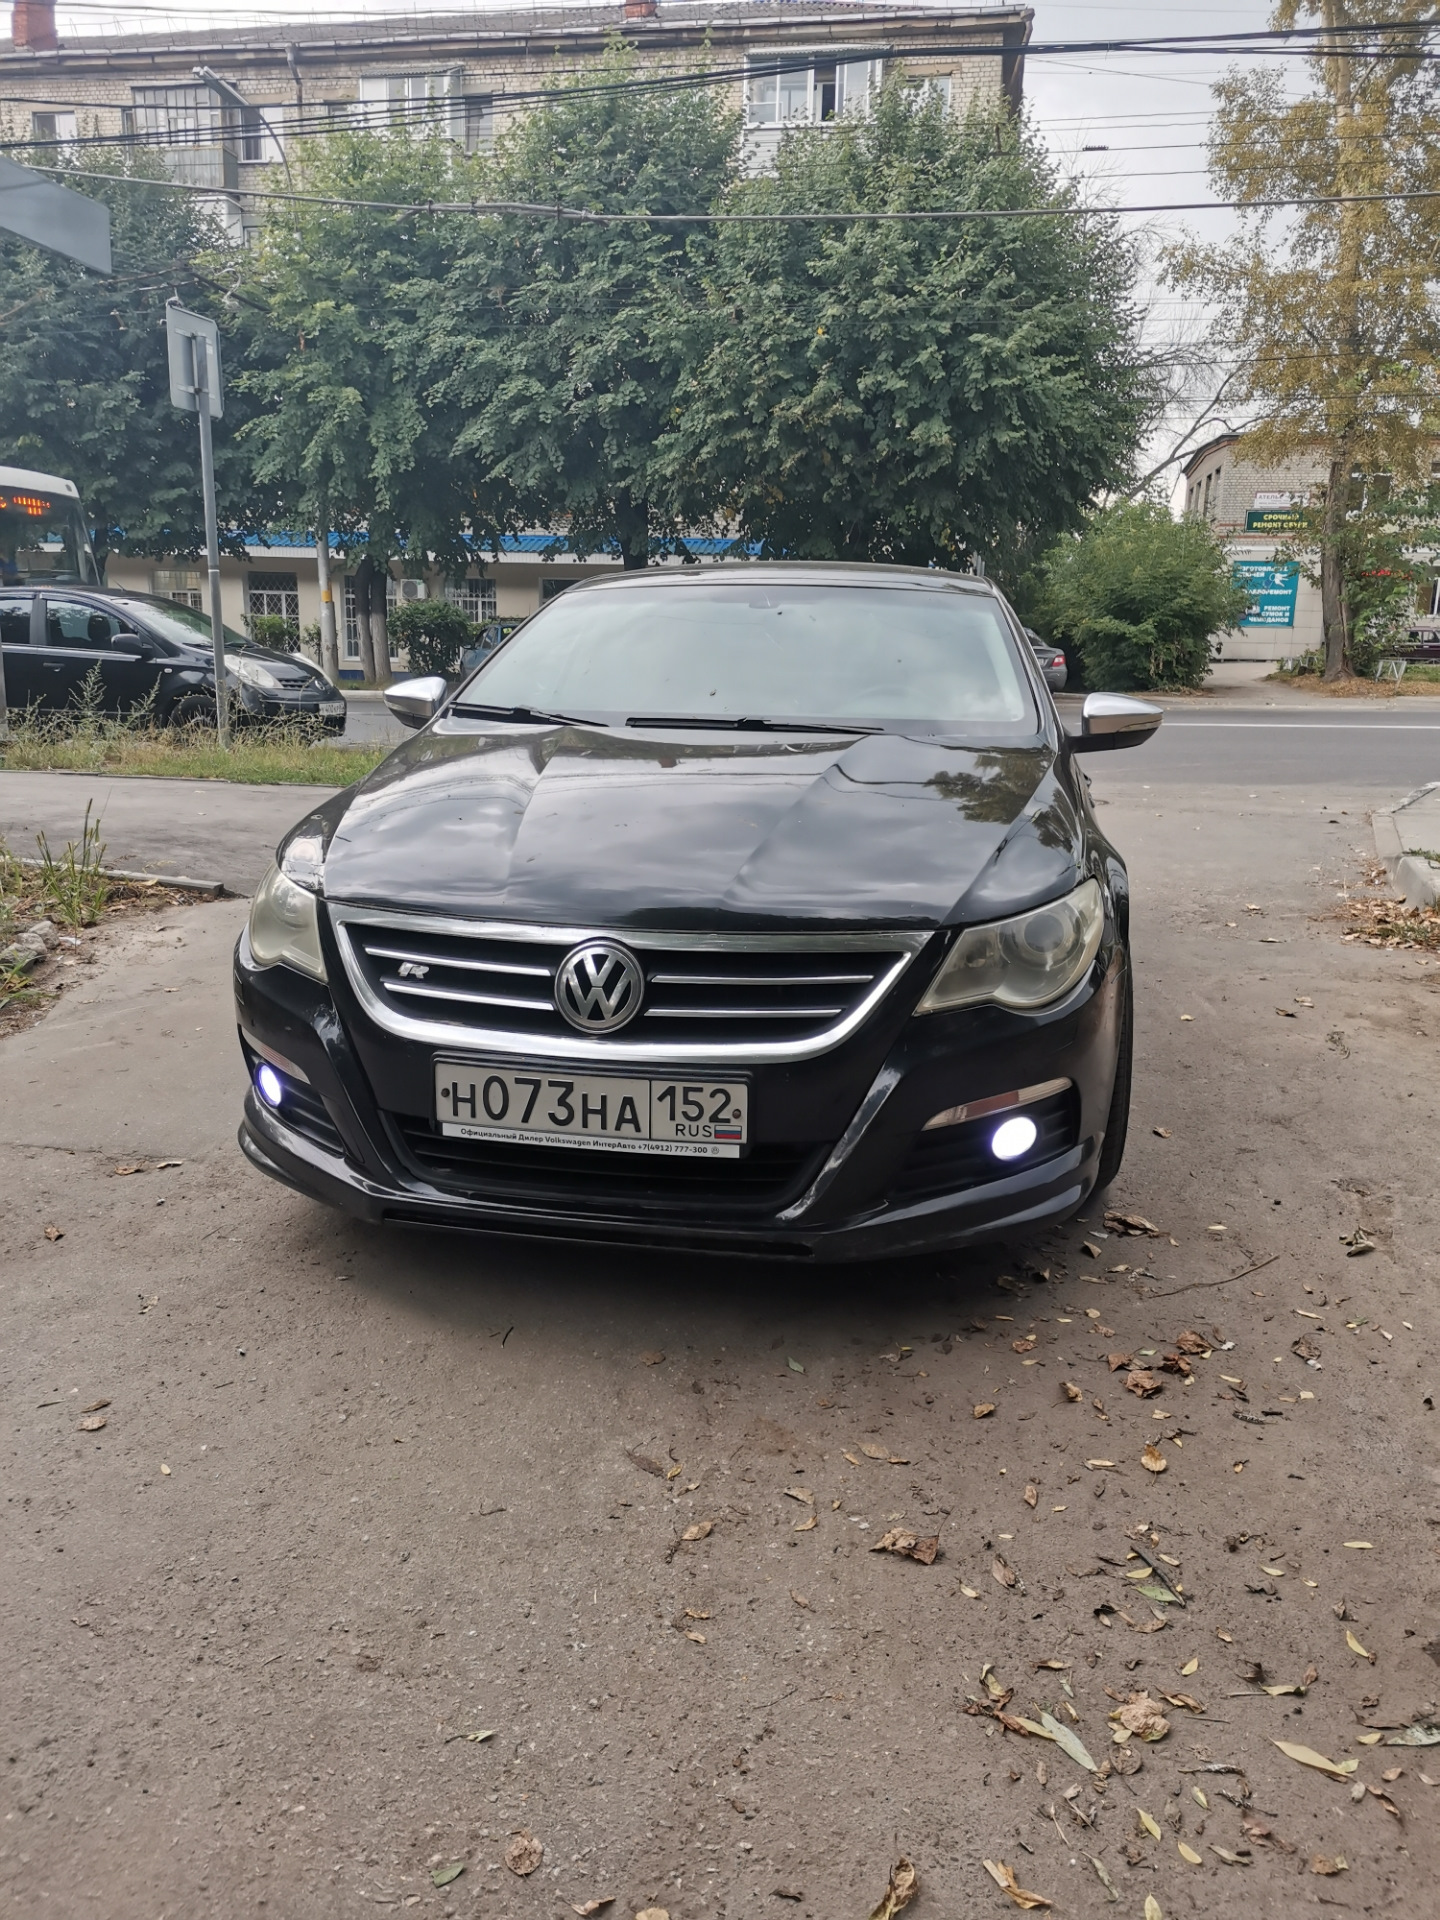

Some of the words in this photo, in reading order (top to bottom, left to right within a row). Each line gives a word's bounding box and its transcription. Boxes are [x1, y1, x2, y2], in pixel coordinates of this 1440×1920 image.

[1253, 521, 1282, 529] РЕМОНТ
[656, 1085, 732, 1124] 152
[460, 1127, 517, 1140] Официальный
[518, 1133, 544, 1144] Дилер
[545, 1136, 591, 1147] Volkswagen
[592, 1140, 636, 1151] ИнтерАвто
[637, 1143, 673, 1153] +7(4912)
[674, 1145, 708, 1154] 777-300
[675, 1123, 713, 1138] RUS
